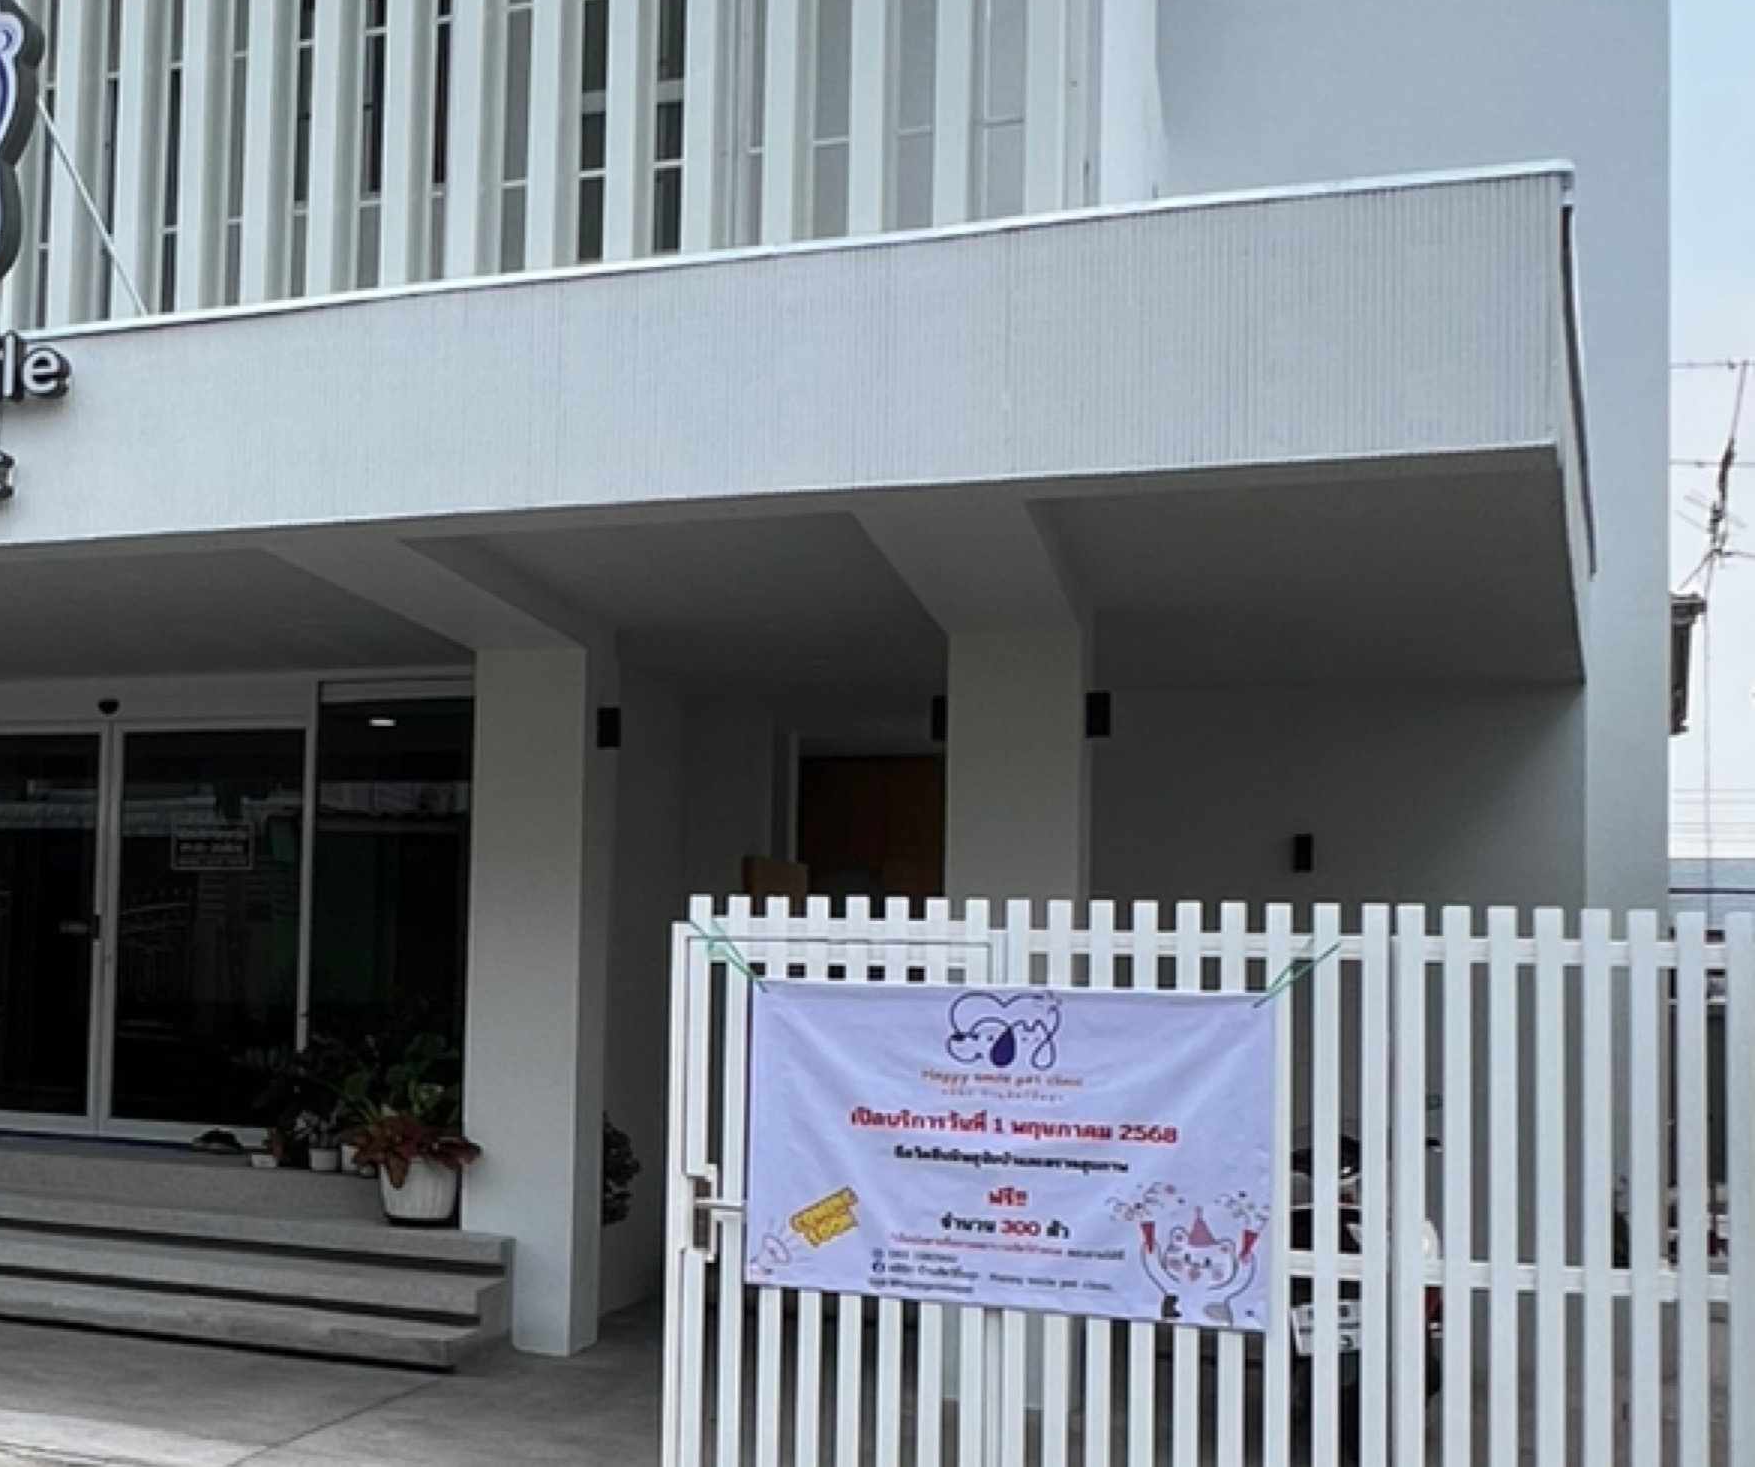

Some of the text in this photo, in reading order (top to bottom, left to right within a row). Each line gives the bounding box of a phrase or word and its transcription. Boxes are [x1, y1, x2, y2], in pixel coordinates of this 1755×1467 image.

[993, 1118, 1005, 1134] 1
[1119, 1123, 1178, 1144] 2568
[1000, 1218, 1043, 1237] 300
